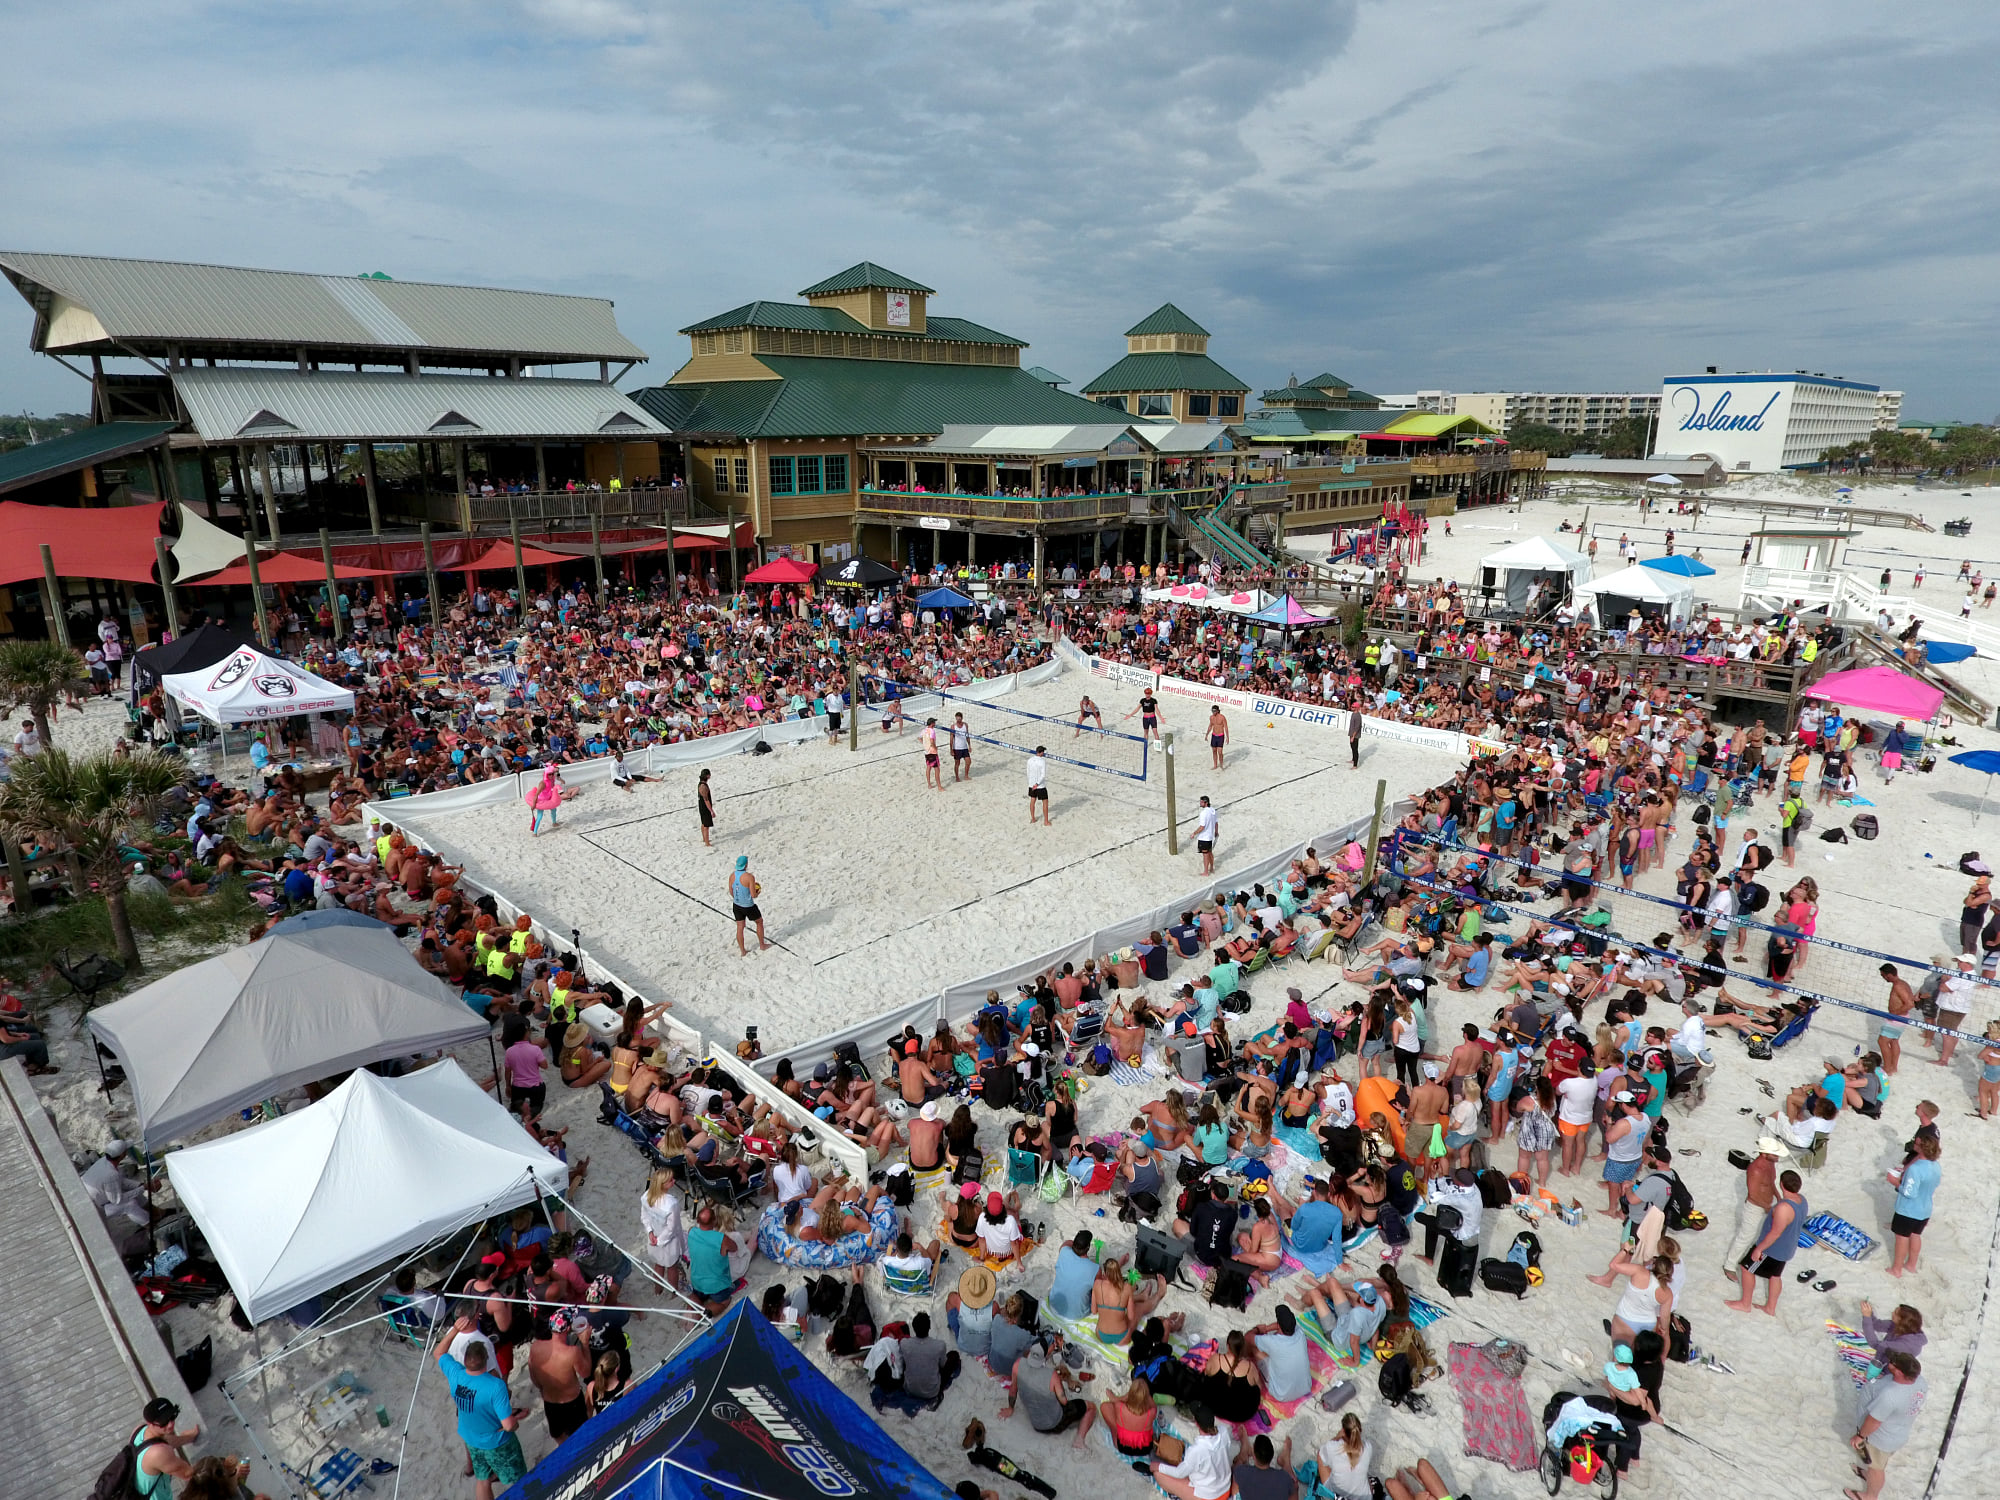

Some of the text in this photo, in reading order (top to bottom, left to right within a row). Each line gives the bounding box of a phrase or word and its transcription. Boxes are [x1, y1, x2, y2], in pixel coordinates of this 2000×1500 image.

[1672, 387, 1781, 431] Island
[1108, 672, 1153, 690] OUR TROOPS
[1110, 665, 1154, 681] WE SUPPORT
[1161, 684, 1243, 707] emeraldcoastvolleyball.com
[299, 700, 336, 711] GEAR
[1255, 701, 1336, 725] BUD LIGHT
[1509, 858, 1524, 866] PARK
[1599, 882, 1616, 892] PARK
[1623, 888, 1637, 897] SUN
[1496, 902, 1511, 912] PARK
[1517, 909, 1530, 917] SUN
[1700, 908, 1718, 918] PARK
[1726, 915, 1741, 923] SUN
[1586, 929, 1602, 939] PARK
[1609, 935, 1622, 944] SUN
[1812, 936, 1832, 947] PARK
[1841, 943, 1858, 953] SUN
[1684, 957, 1703, 968] PARK
[1710, 965, 1725, 974] SUN
[1937, 967, 1960, 978] PARK
[1970, 975, 1990, 984] SUN
[1794, 988, 1814, 999] PARK
[1823, 996, 1840, 1005] SUN
[1917, 1022, 1940, 1032] PARK
[1949, 1030, 1968, 1040] SUN
[1339, 1098, 1346, 1112] 9
[553, 1385, 696, 1500] C2 ATTAC
[726, 1386, 856, 1497] C2 ATTACK
[758, 1384, 869, 1494] VOLLEYBALL CLUB
